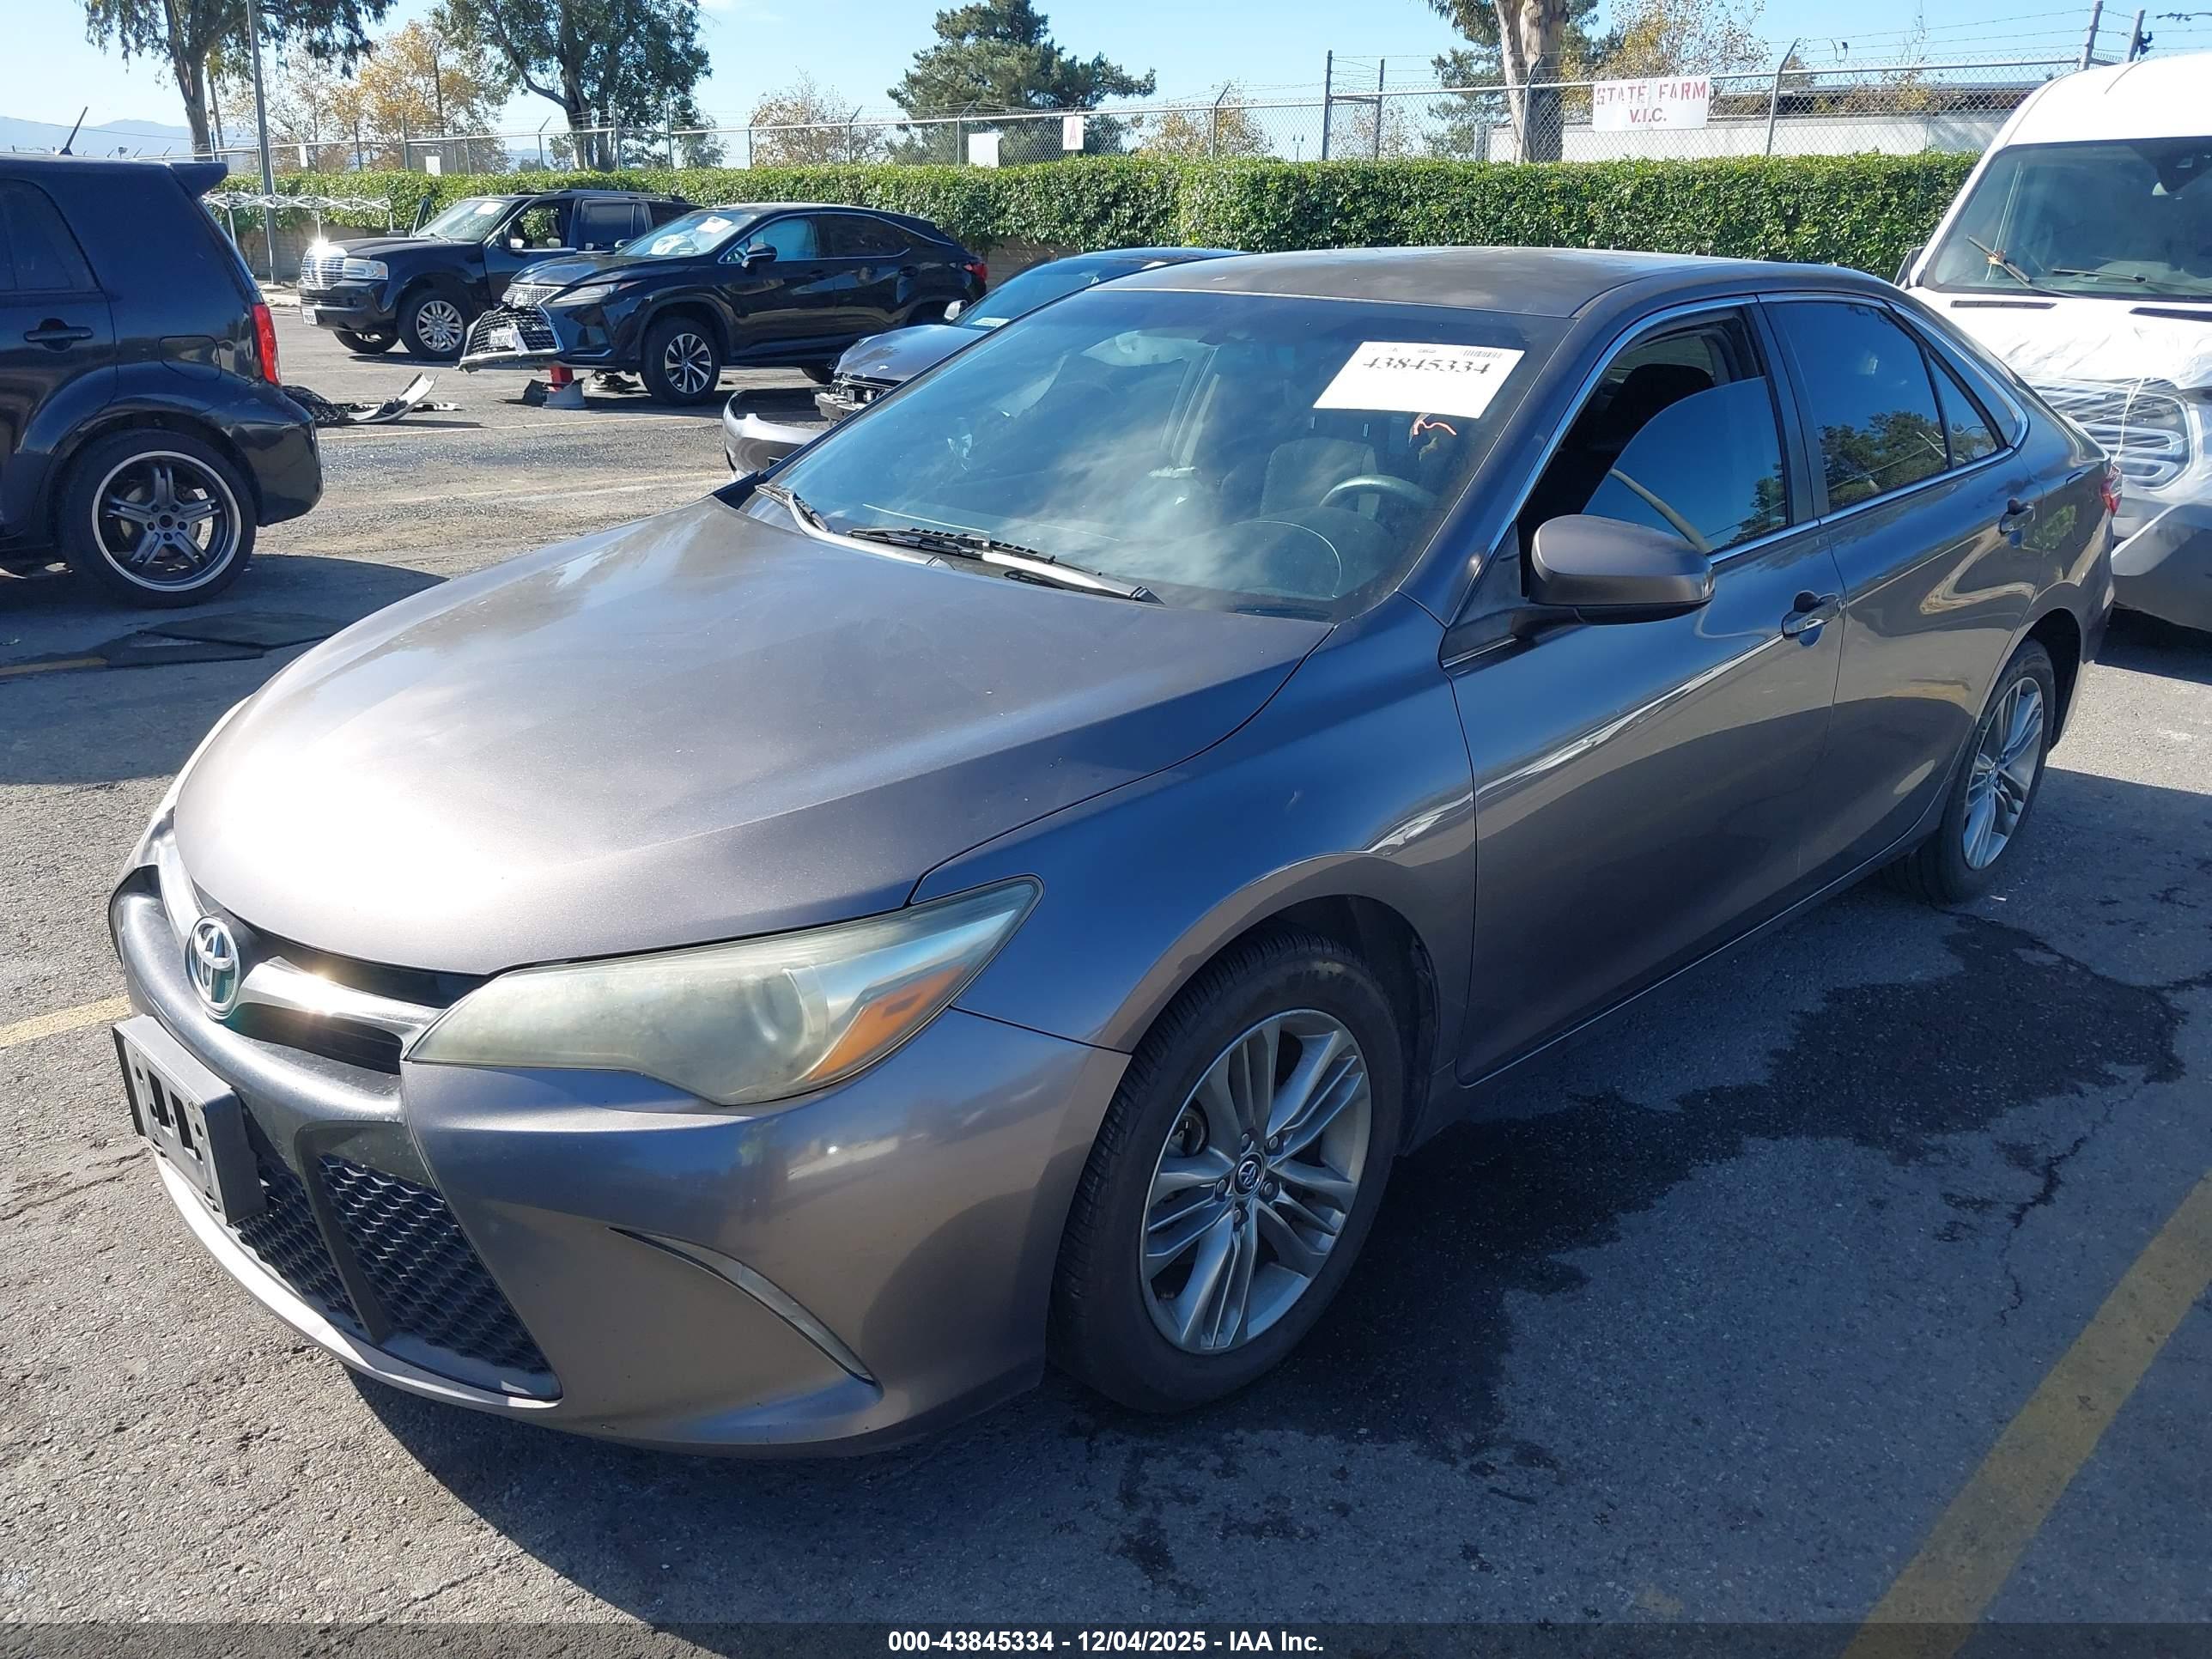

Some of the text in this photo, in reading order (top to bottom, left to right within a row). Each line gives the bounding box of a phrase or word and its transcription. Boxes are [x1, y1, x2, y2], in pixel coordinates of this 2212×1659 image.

[1596, 81, 1706, 106] STATE FARM
[1629, 107, 1668, 124] V.I.C.
[1363, 356, 1492, 374] 43845334
